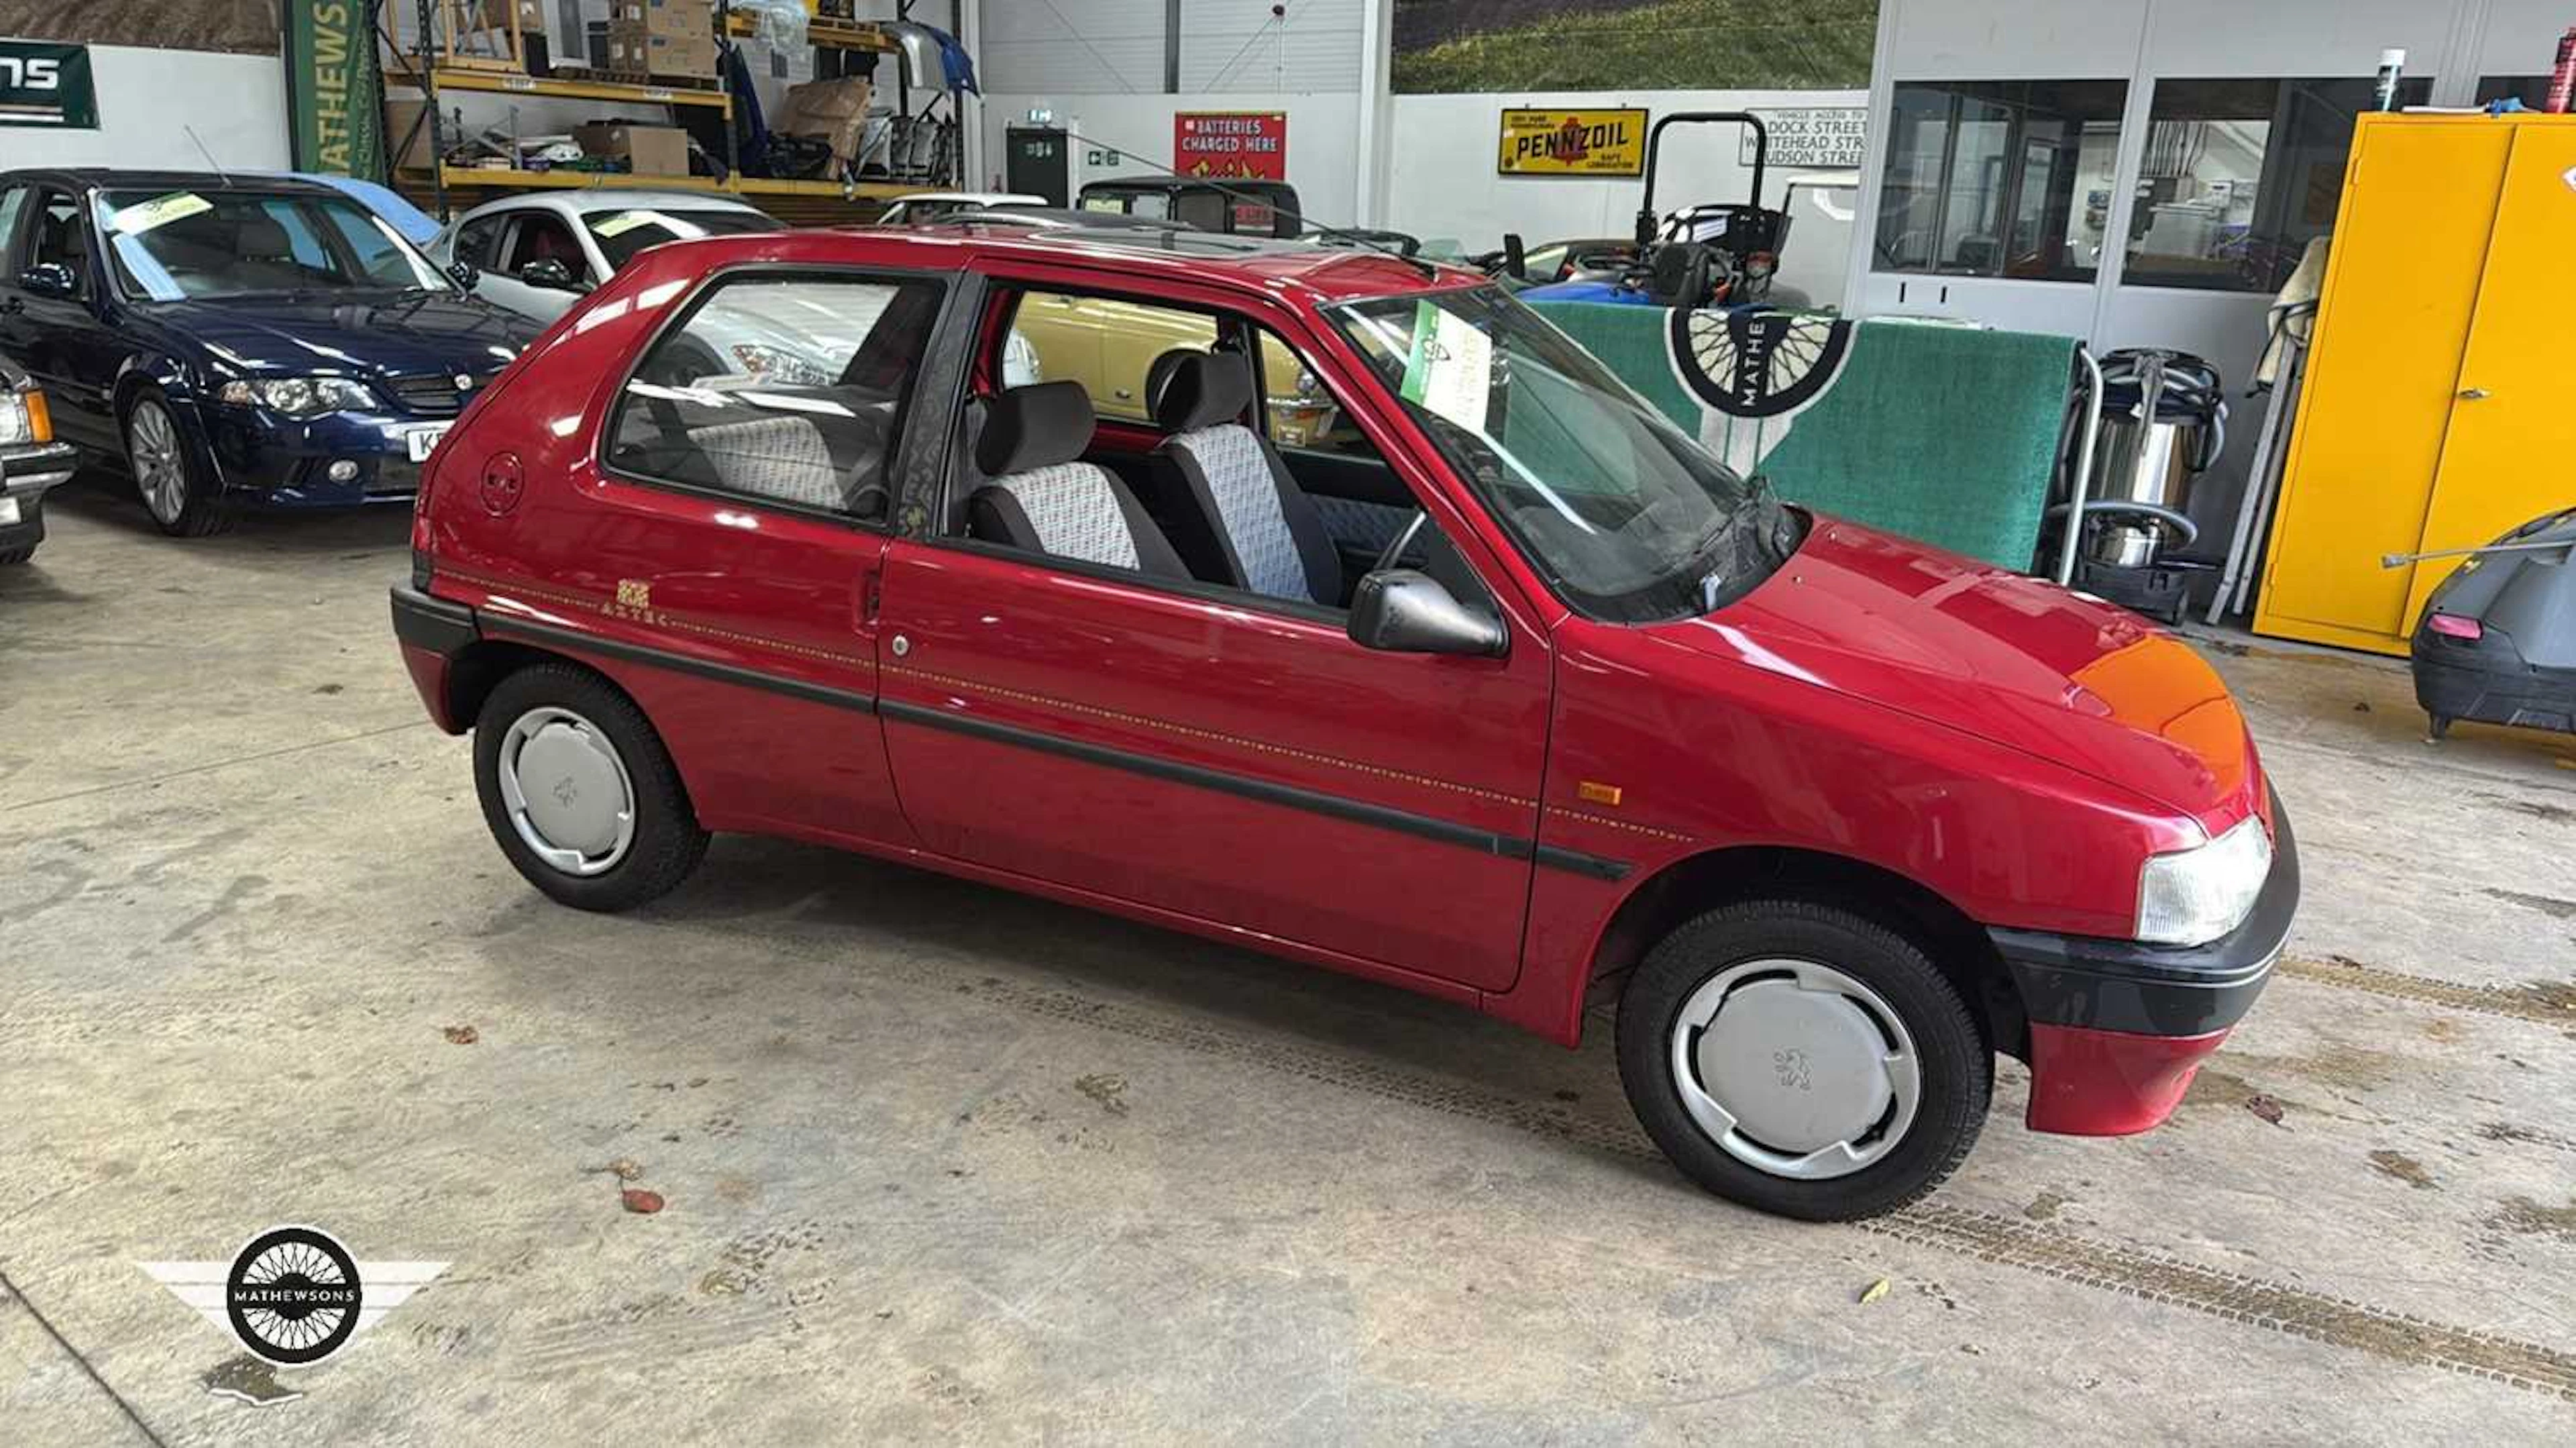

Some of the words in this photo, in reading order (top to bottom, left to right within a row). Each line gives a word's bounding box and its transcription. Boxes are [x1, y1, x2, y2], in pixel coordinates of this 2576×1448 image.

[313, 1, 351, 177] ATHEWS
[1197, 119, 1262, 134] BATTERIES
[1768, 121, 1810, 134] DOCK
[1182, 136, 1239, 152] CHARGED
[1245, 137, 1277, 152] HERE
[1517, 121, 1629, 161] PENNZOIL
[1745, 136, 1830, 149] WITEHEAD
[1835, 136, 1865, 149] STR
[1766, 150, 1814, 163] UDSON
